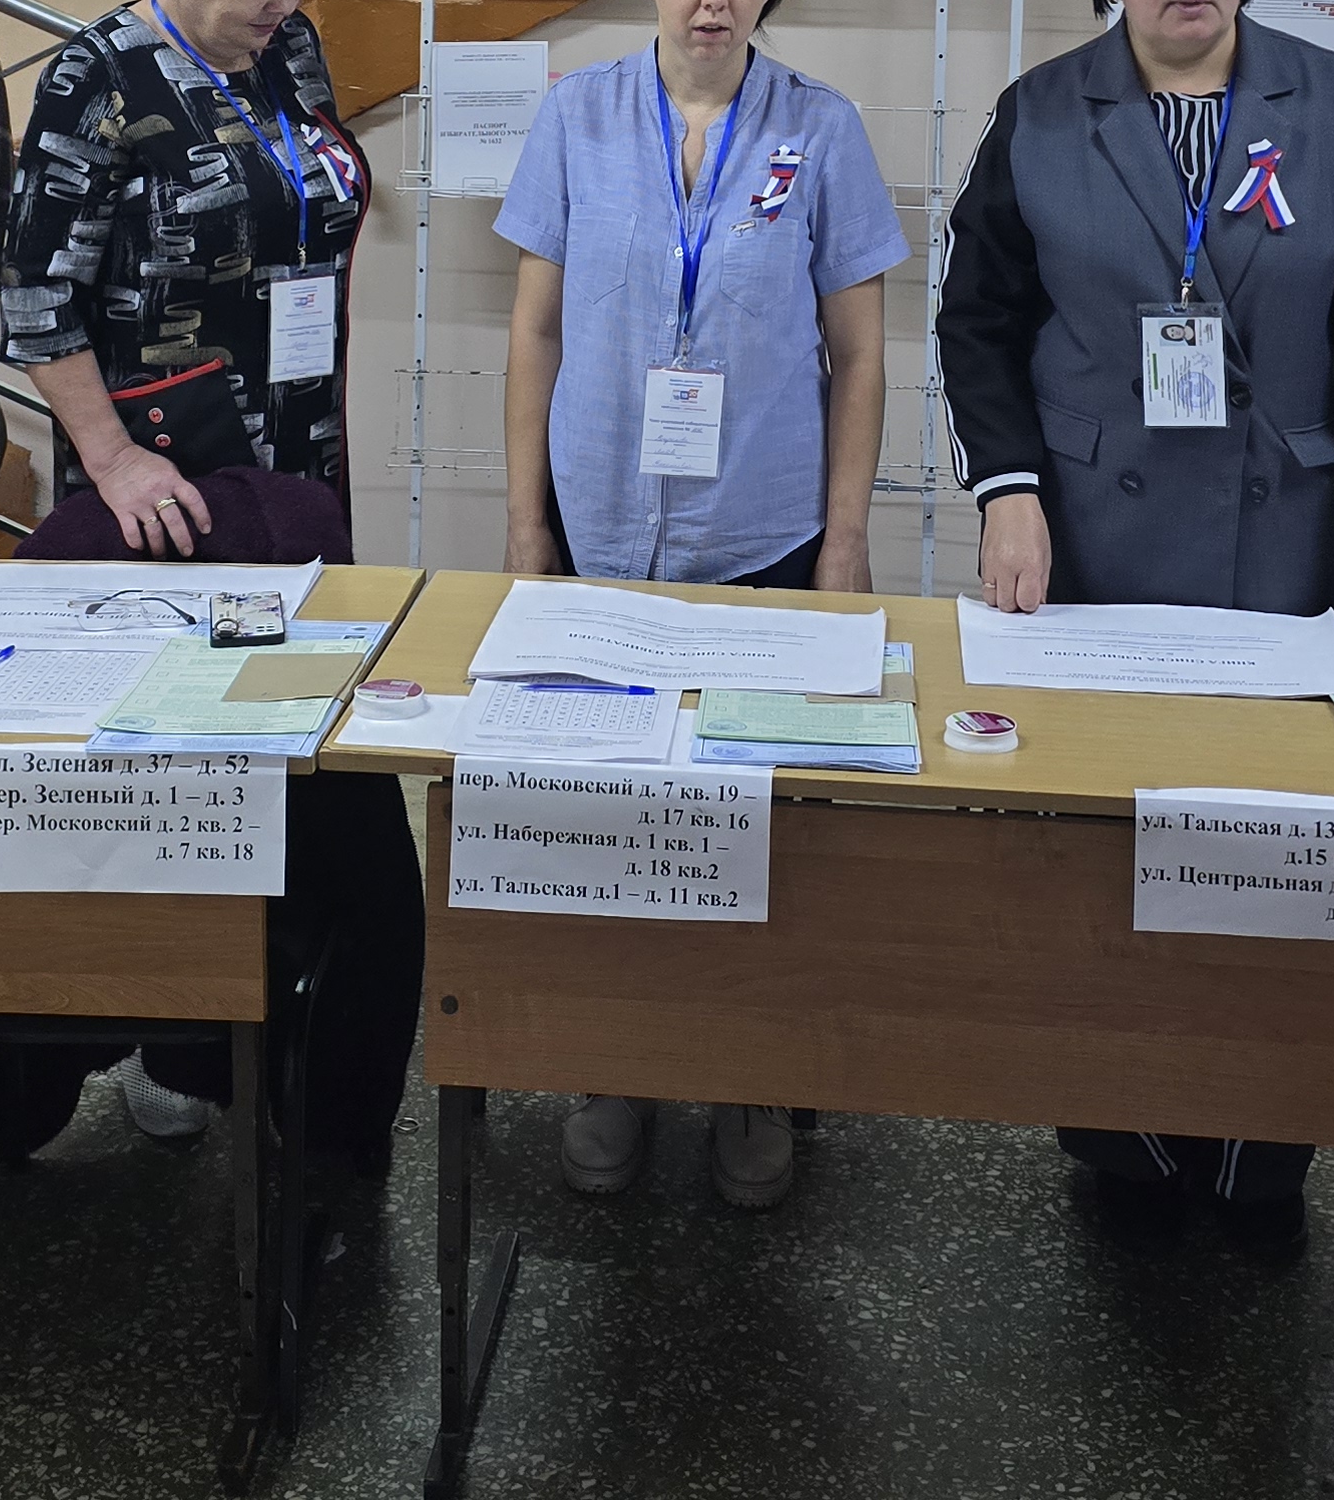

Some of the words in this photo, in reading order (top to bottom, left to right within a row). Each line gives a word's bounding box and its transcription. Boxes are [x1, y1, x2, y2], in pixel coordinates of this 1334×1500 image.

[21, 752, 114, 773] Зеленая
[119, 759, 139, 777] д.
[146, 754, 173, 775] 37
[196, 760, 217, 777] д.
[224, 754, 250, 775] 52
[34, 784, 134, 805] Зеленый
[141, 790, 160, 807] д.
[169, 785, 179, 805] 1
[204, 791, 225, 808] д.
[232, 786, 244, 805] 3
[459, 772, 500, 792] пер.
[506, 771, 633, 796] Московский
[638, 784, 656, 799] д.
[663, 781, 674, 799] 7
[680, 786, 710, 801] кв.
[718, 784, 738, 802] 19
[27, 814, 151, 833] Московский
[156, 819, 174, 835] д.
[179, 816, 190, 833] 2
[196, 820, 226, 833] кв.
[232, 816, 243, 833] 2
[637, 809, 655, 826] д.
[663, 808, 684, 826] 17
[690, 813, 721, 828] кв.
[728, 813, 749, 830] 16
[1141, 814, 1172, 832] ул.
[1179, 812, 1282, 836] Тальская
[1288, 823, 1306, 839] д.
[456, 824, 486, 843] ул.
[494, 822, 618, 848] Набережная
[623, 834, 640, 850] д.
[648, 833, 655, 850] 1
[664, 838, 694, 853] кв.
[700, 837, 709, 854] 1
[155, 845, 173, 861] д.
[179, 842, 190, 860] 7
[196, 846, 225, 860] кв.
[233, 843, 254, 861] 18
[1283, 848, 1327, 866] д.15
[624, 860, 642, 877] д.
[650, 859, 671, 877] 18
[677, 863, 719, 880] кв.2
[1140, 866, 1172, 884] ул.
[1178, 865, 1322, 892] Центральная
[455, 877, 484, 895] ул.
[491, 875, 587, 898] Тальская
[593, 883, 620, 901] д.1
[644, 888, 661, 904] д.
[669, 887, 689, 905] 11
[697, 891, 739, 908] кв.2
